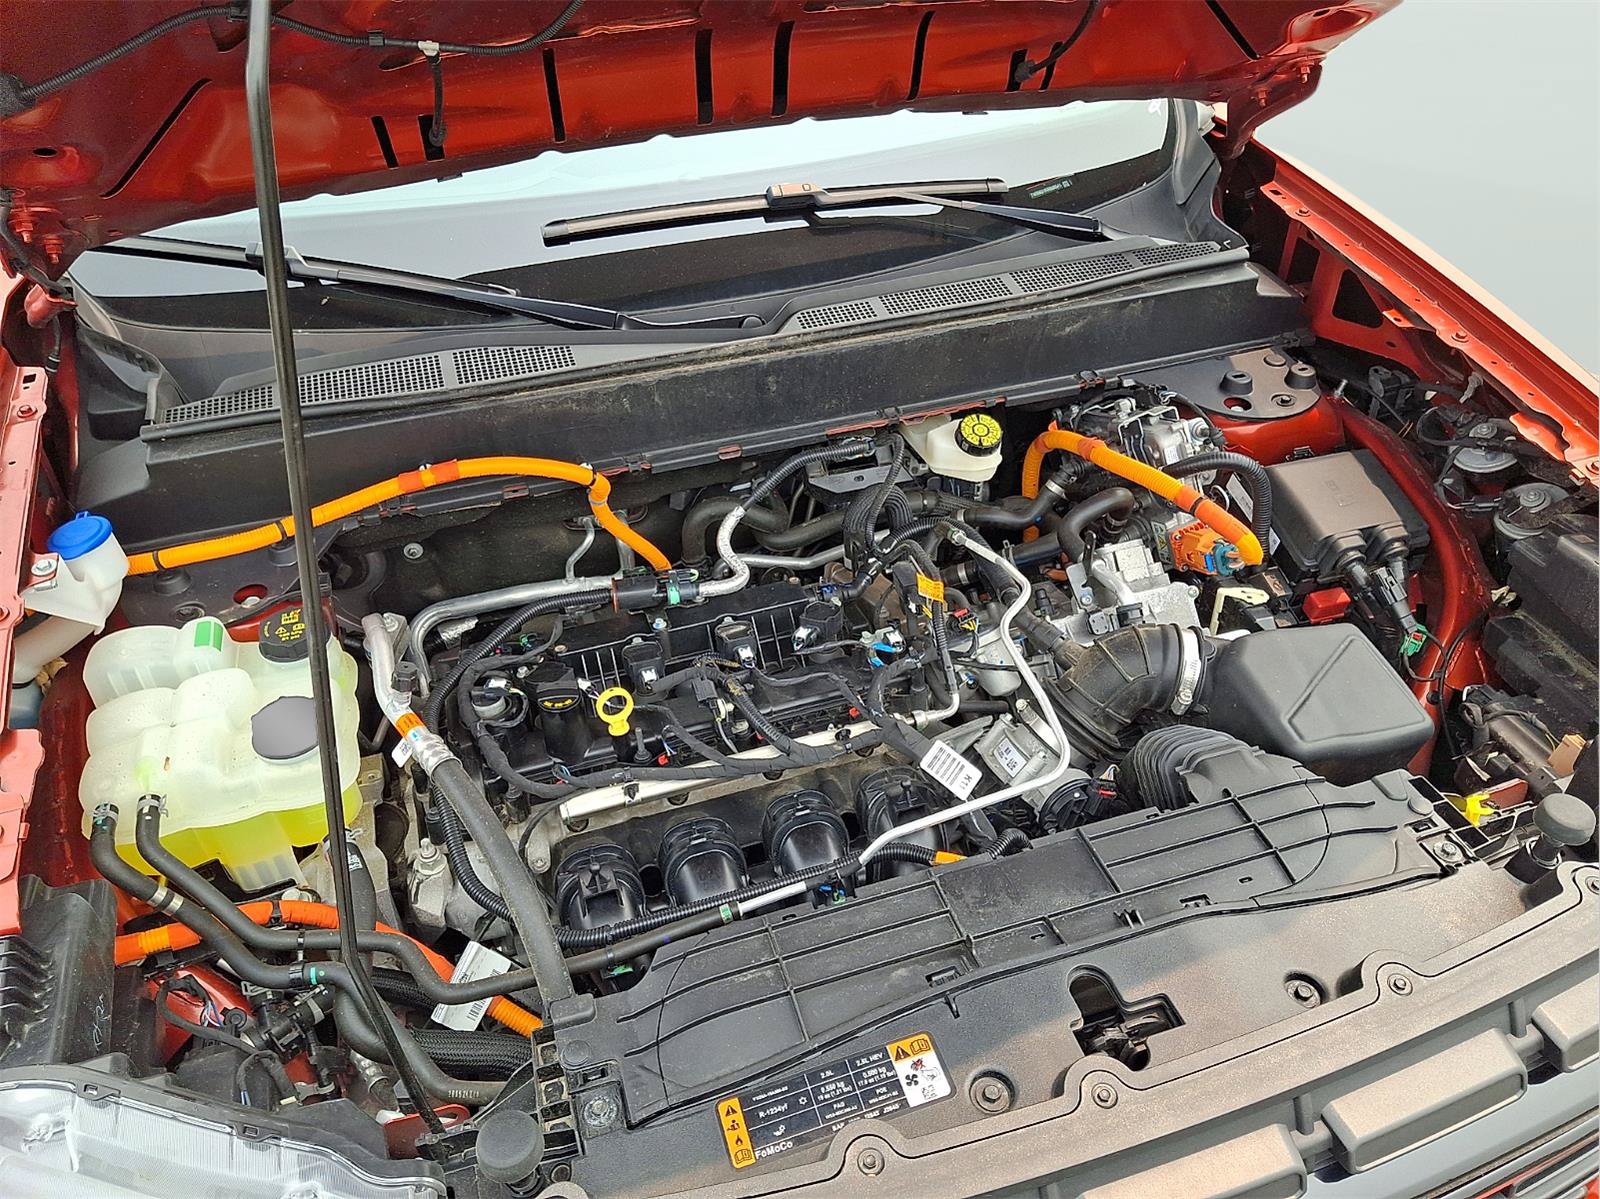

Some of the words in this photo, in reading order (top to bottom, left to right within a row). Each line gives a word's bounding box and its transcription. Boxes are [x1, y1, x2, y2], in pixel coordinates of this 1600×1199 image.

[869, 1052, 883, 1062] HEV
[759, 1103, 788, 1118] R-1234yf
[755, 1141, 793, 1160] FoMoCo
